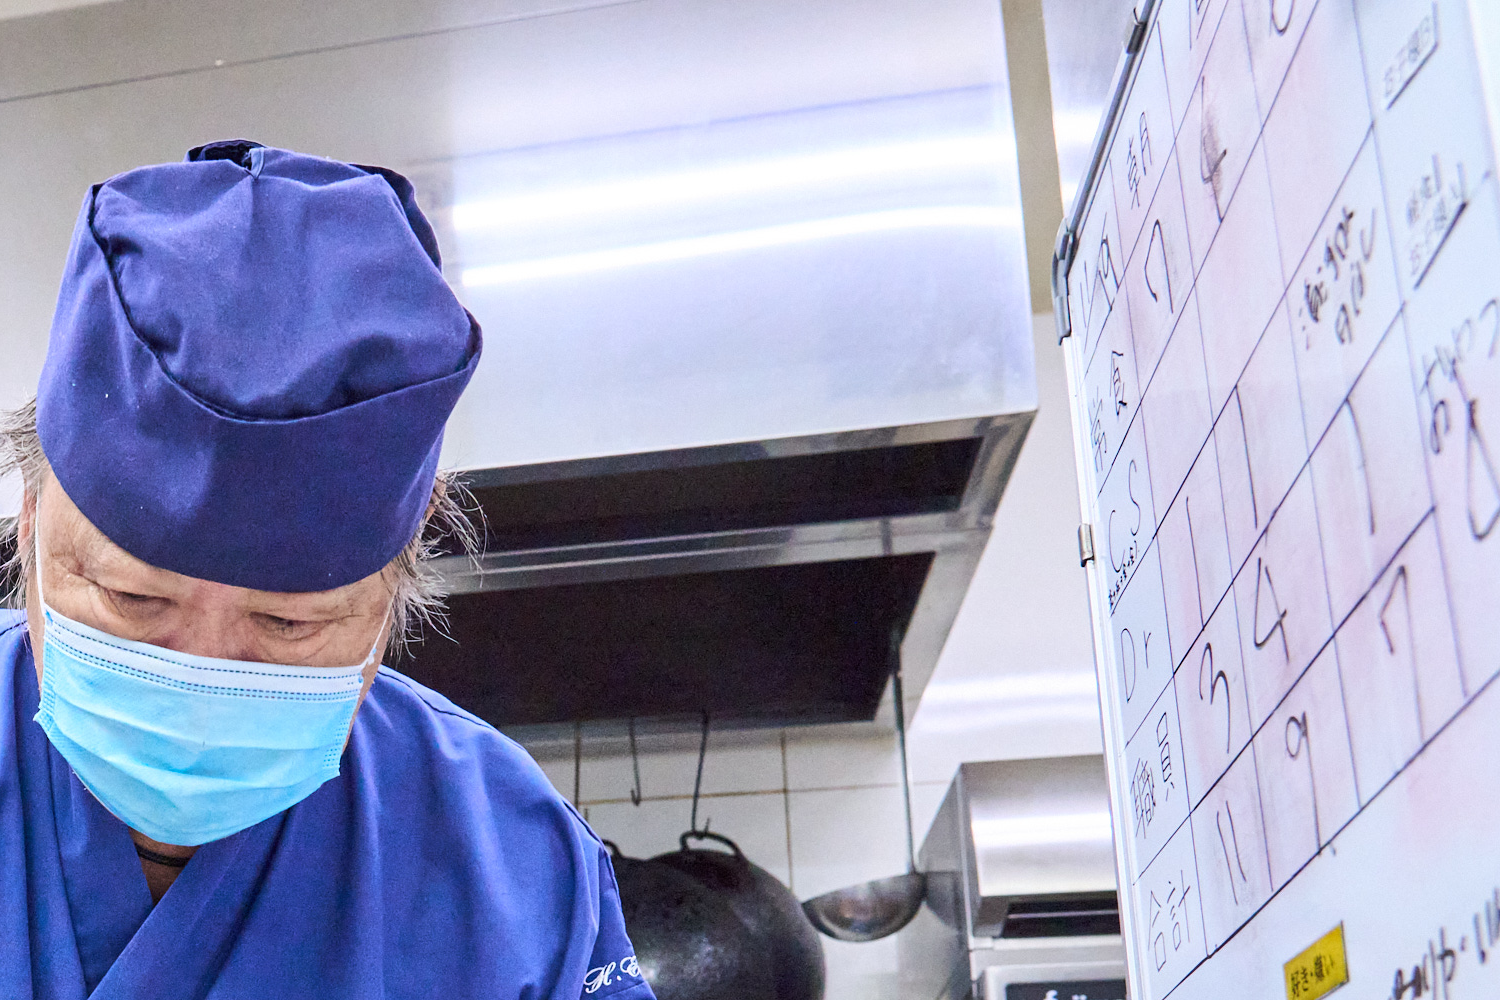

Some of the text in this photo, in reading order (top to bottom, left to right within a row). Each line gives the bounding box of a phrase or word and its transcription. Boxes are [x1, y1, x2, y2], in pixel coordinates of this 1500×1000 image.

[1254, 557, 1290, 664] 4
[1120, 628, 1152, 704] Dr
[1199, 642, 1231, 754] 3
[1131, 711, 1175, 839] 職員
[1149, 870, 1192, 971] 合計
